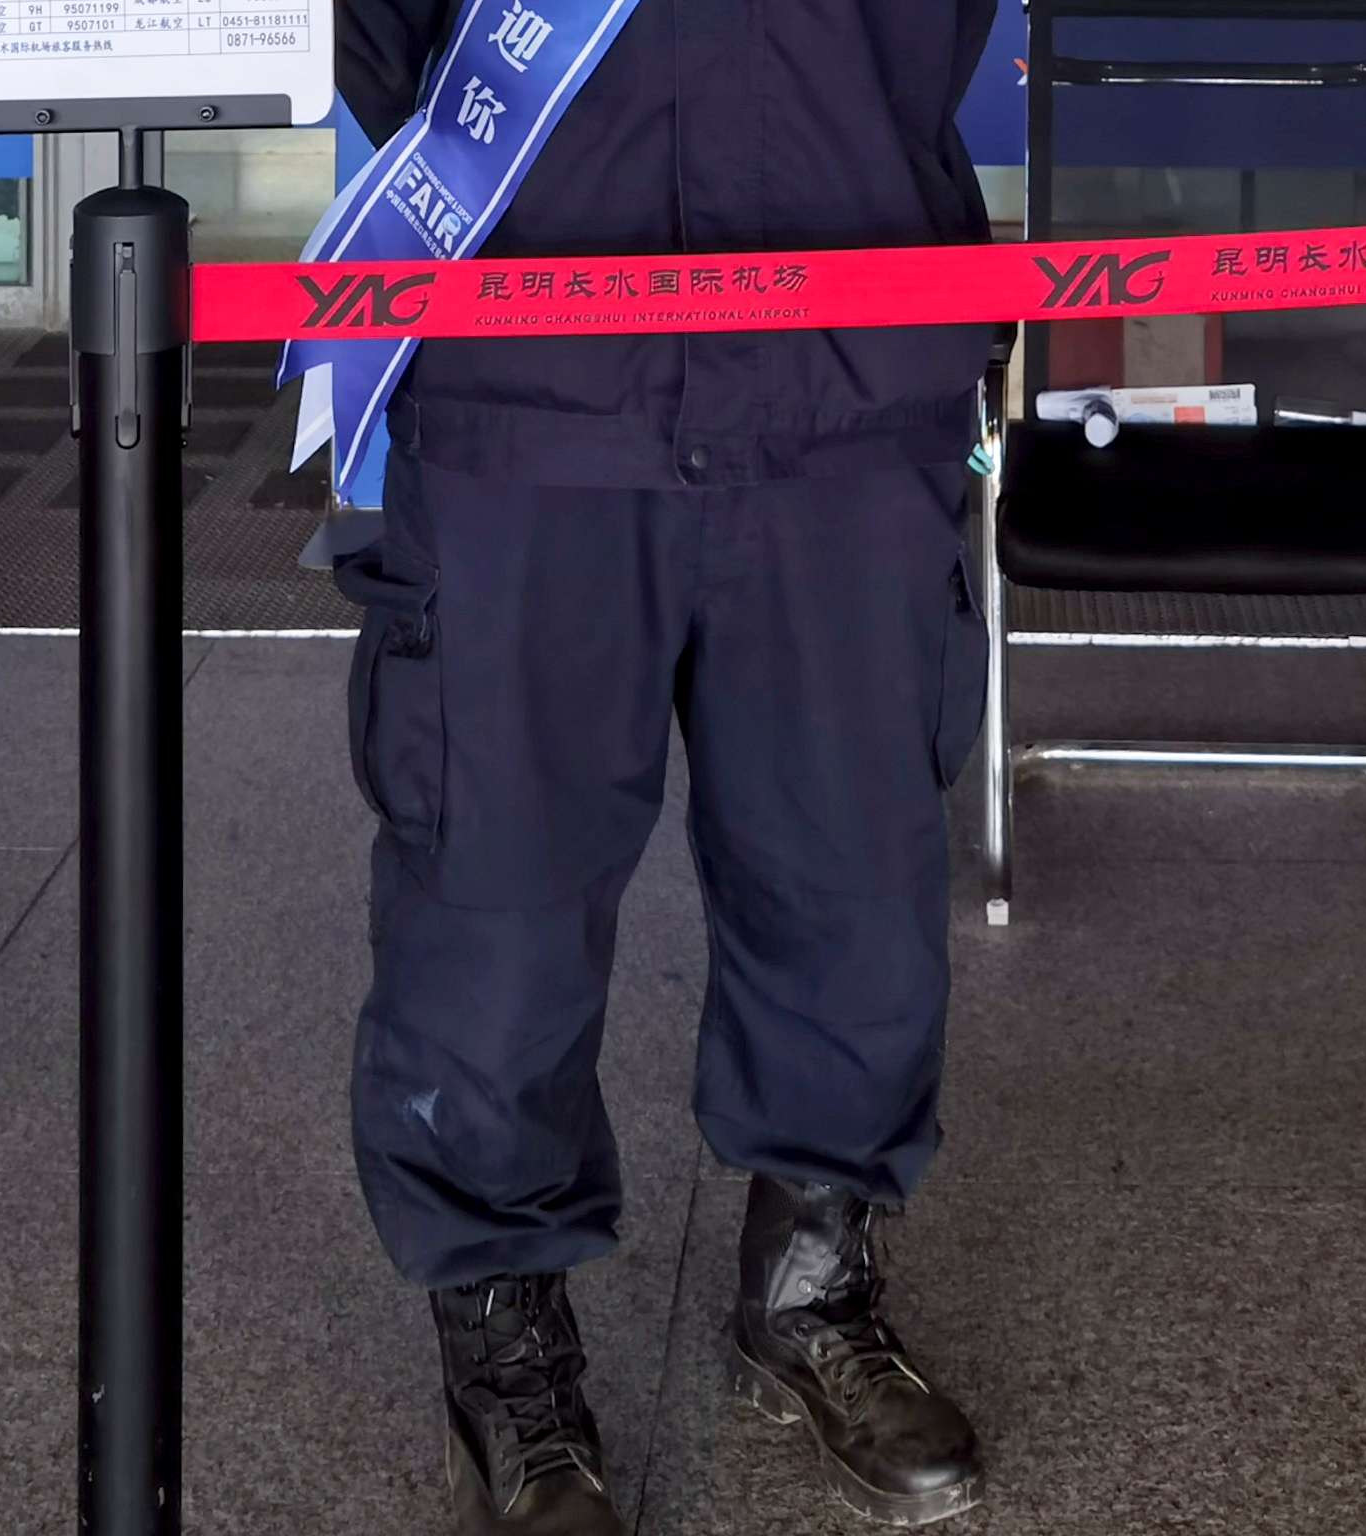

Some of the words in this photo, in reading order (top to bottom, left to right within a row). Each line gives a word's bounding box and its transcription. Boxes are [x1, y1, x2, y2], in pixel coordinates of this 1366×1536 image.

[226, 33, 297, 48] 0871-96566
[393, 161, 461, 253] FAIR
[477, 264, 809, 301] 昆明长水国际机场
[474, 314, 539, 326] KUNMING
[545, 313, 627, 325] CHANGSHUI
[633, 310, 744, 323] INTERNATIONAL
[749, 307, 811, 320] AIRPORT
